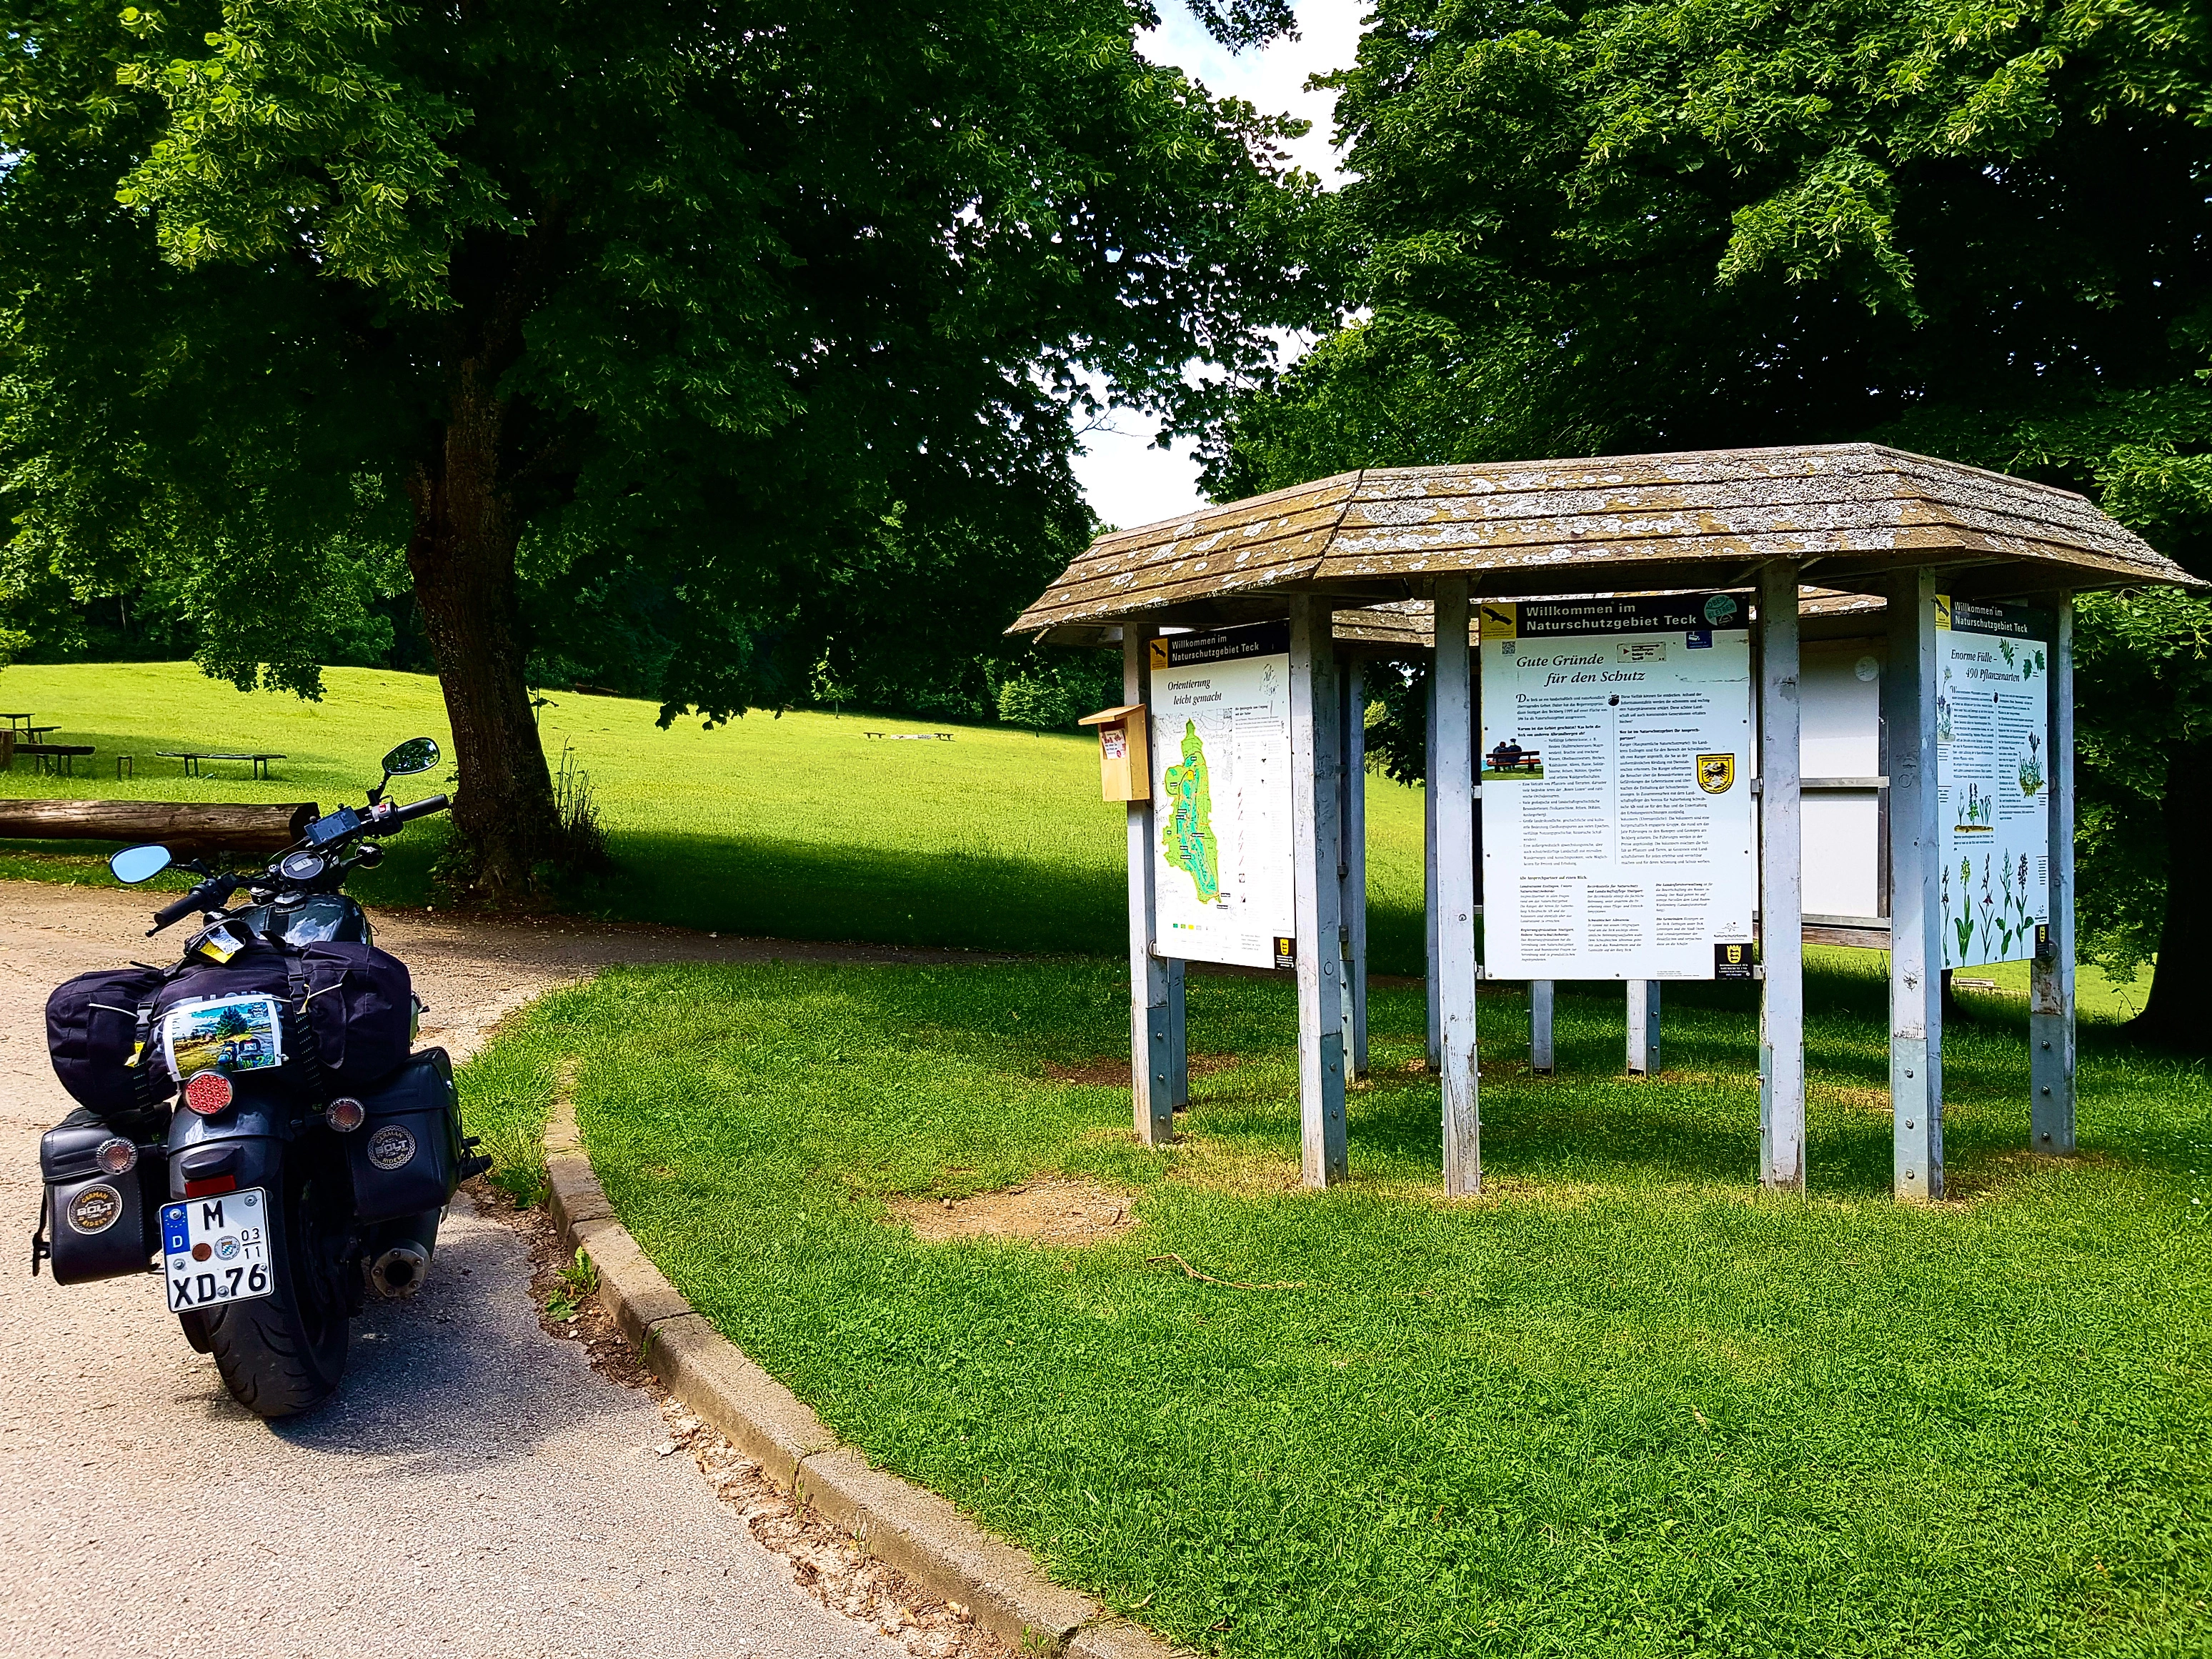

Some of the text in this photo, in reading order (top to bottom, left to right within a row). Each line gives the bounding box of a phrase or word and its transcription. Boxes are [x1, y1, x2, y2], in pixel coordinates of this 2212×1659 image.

[1707, 596, 1726, 607] OBEN
[1526, 603, 1635, 617] Willkommen im
[1954, 602, 2003, 617] Willkommen im
[1527, 614, 1697, 631] Naturschutzgebiet Teck
[1955, 615, 2013, 631] Naturschutzgebiet
[2013, 622, 2028, 633] Teck
[1172, 637, 1216, 649] Willkommen
[1172, 642, 1260, 662] Naturschutzgebiet Teck
[1951, 649, 1976, 661] Enorme
[1977, 652, 1993, 662] Fülle
[1516, 654, 1605, 667] Gute Gründe
[1543, 670, 1645, 687] für den Schutz
[1966, 667, 1978, 679] 490
[1980, 669, 2020, 682] Pflanzenarten
[1167, 679, 1211, 691] Orientierung
[1173, 691, 1222, 705] leicht gemacht
[376, 1131, 404, 1144] GERMAN
[375, 1140, 407, 1155] BOLT
[382, 1153, 405, 1164] RIDERS
[81, 1192, 109, 1203] GERMAN
[76, 1202, 114, 1216] BOLT
[202, 1200, 224, 1230] M
[82, 1217, 107, 1227] RIDERS
[172, 1235, 183, 1247] D
[241, 1227, 259, 1241] 03
[244, 1246, 260, 1259] 11
[173, 1263, 266, 1308] XD 76
